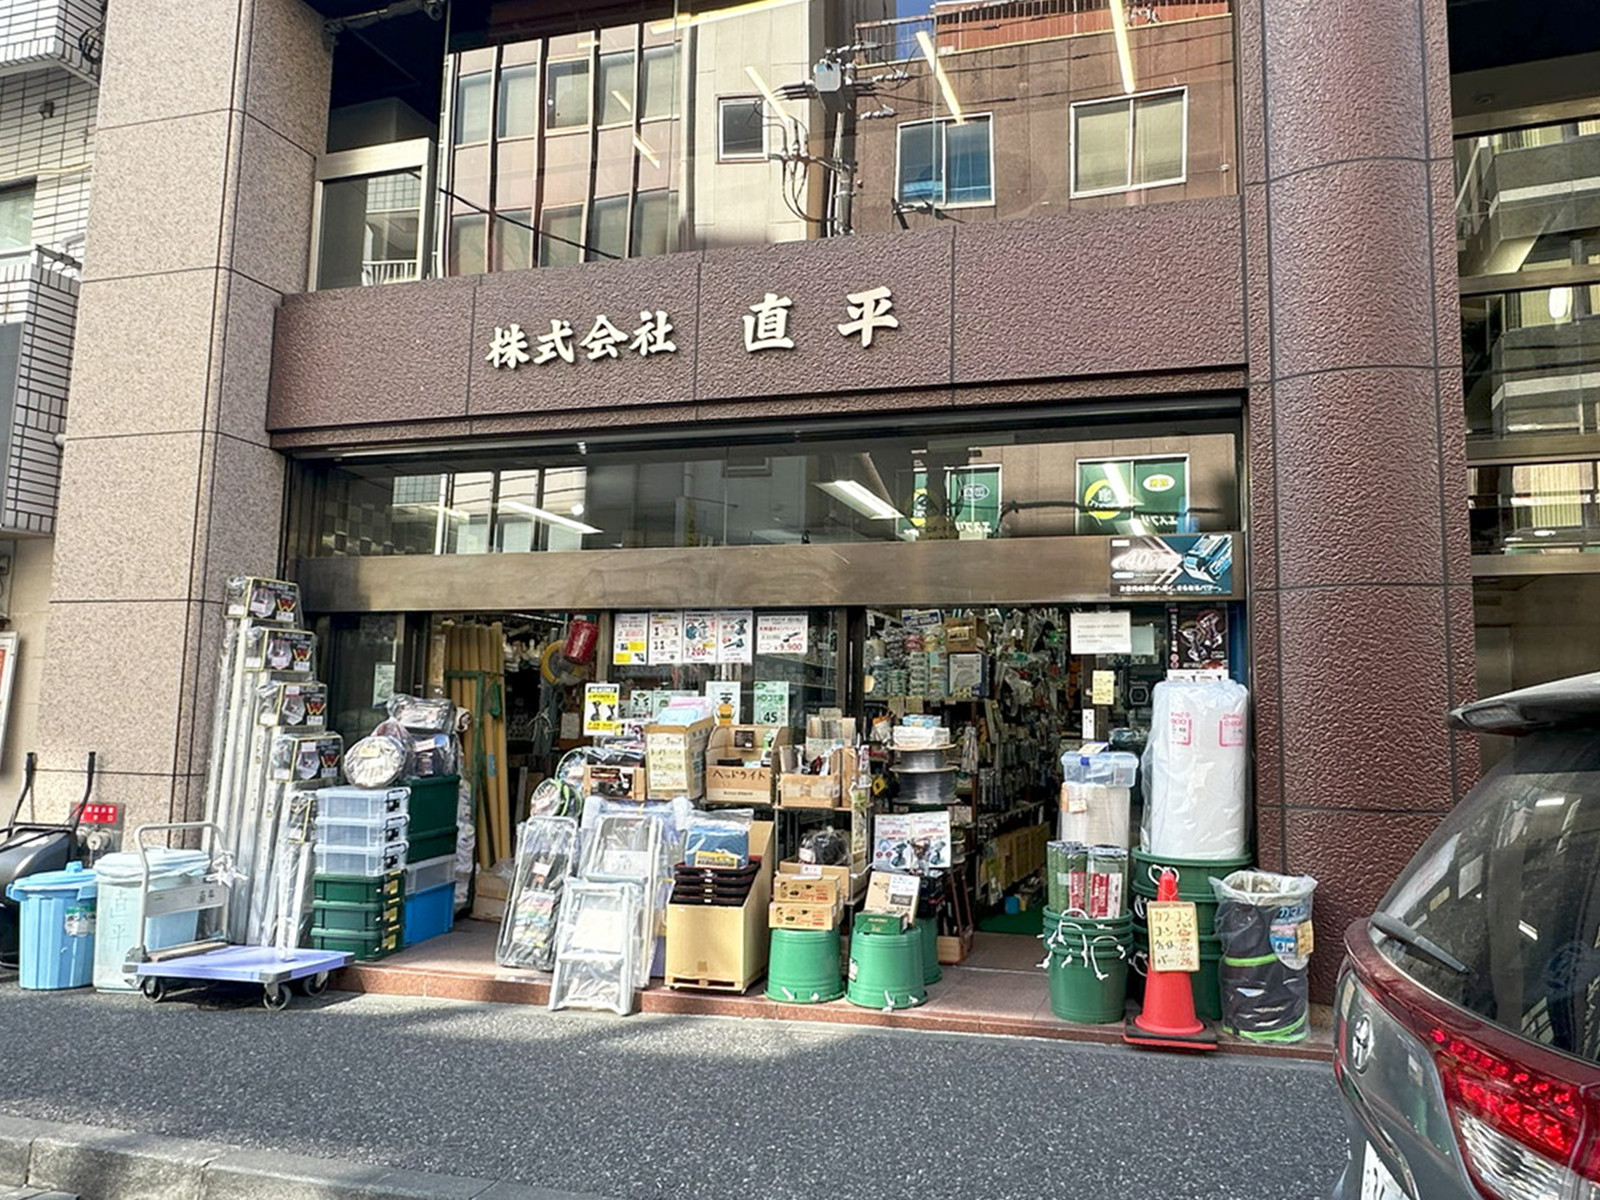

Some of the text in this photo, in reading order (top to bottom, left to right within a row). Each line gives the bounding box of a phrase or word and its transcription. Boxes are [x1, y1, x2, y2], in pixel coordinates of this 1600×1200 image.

[484, 309, 678, 370] 株式会社
[763, 711, 778, 724] 45
[712, 769, 766, 781] ヘッドライト
